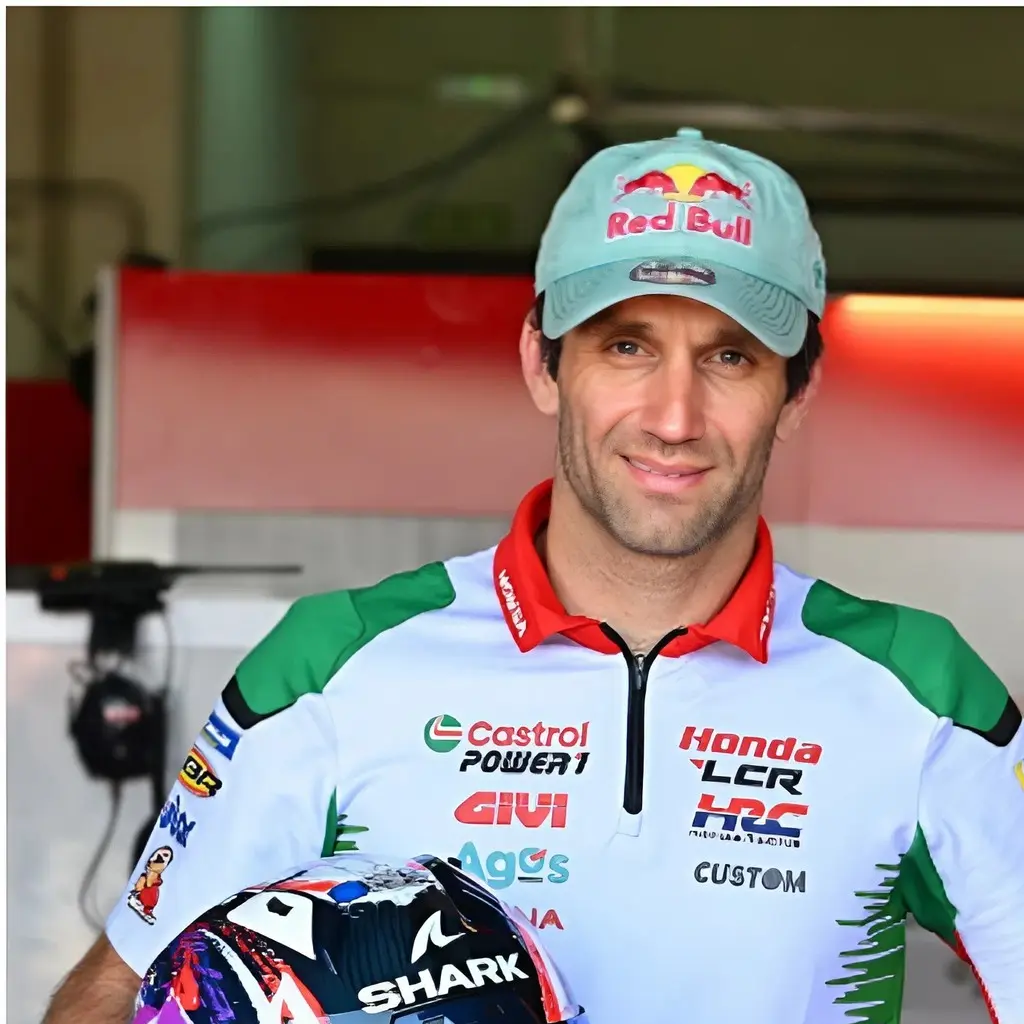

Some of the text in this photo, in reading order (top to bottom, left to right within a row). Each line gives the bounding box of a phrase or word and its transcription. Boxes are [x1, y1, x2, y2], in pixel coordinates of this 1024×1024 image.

[605, 201, 751, 247] Red Bull
[467, 721, 591, 748] Castrol
[678, 726, 823, 766] Honda
[700, 759, 803, 796] LCR
[454, 791, 568, 828] GIVI
[691, 793, 810, 838] HRC
[357, 952, 529, 1015] SHARK
